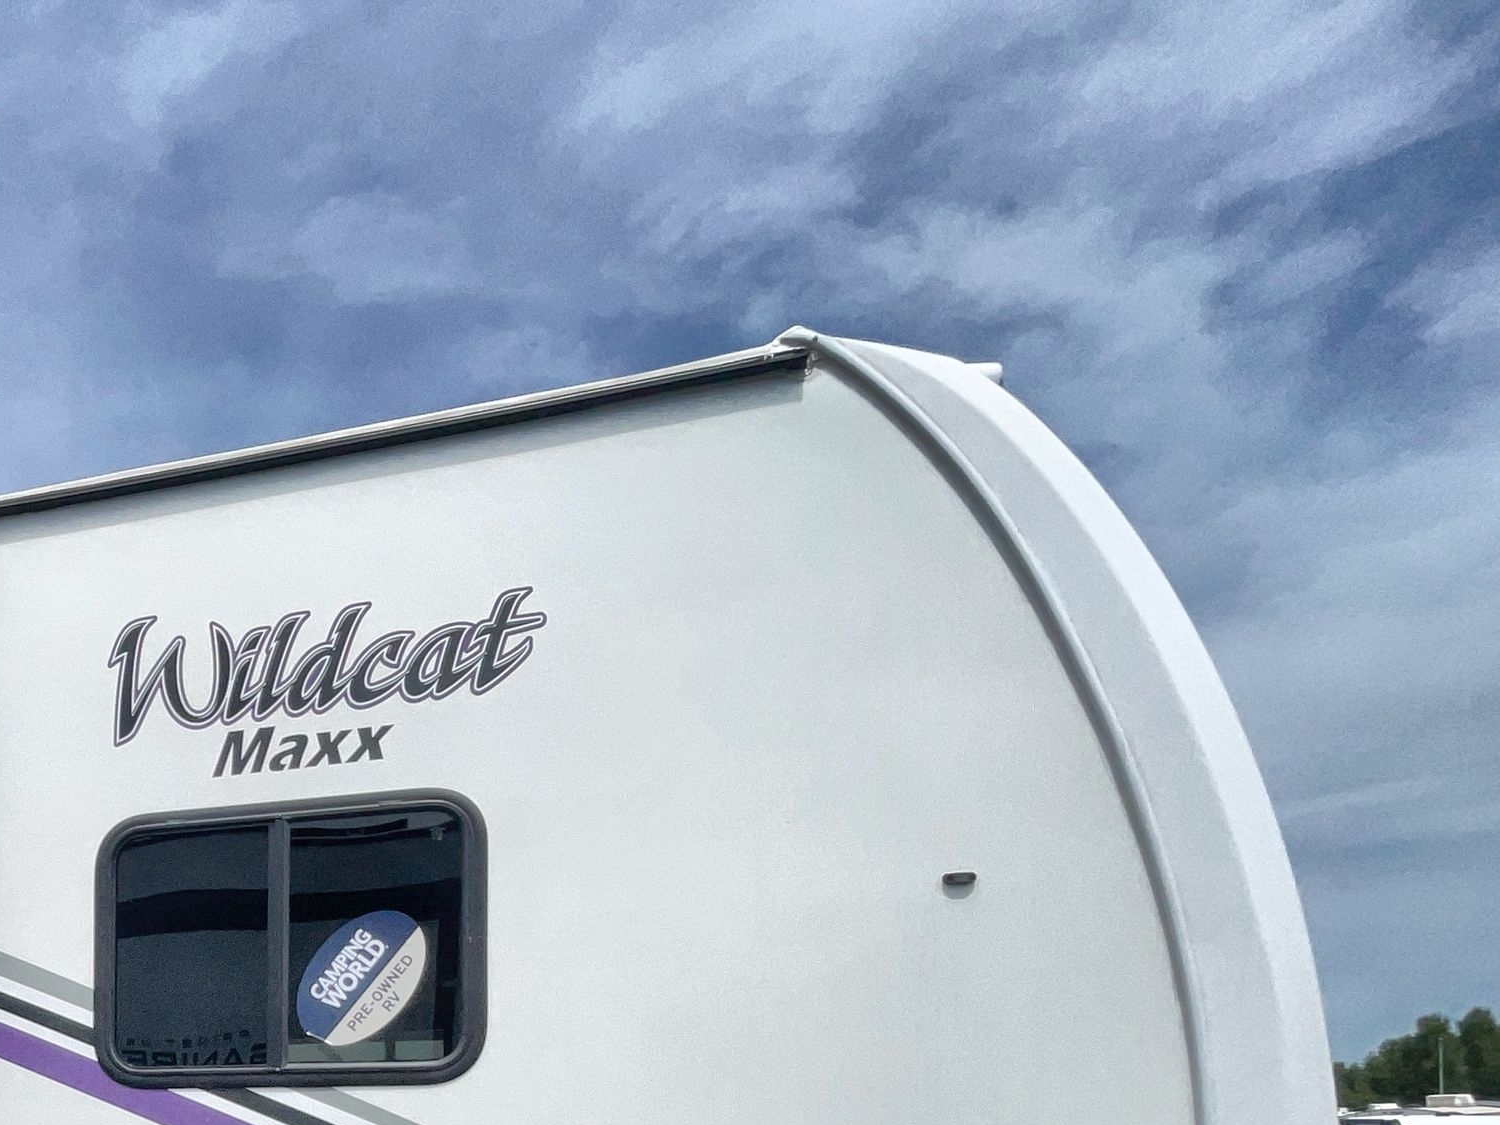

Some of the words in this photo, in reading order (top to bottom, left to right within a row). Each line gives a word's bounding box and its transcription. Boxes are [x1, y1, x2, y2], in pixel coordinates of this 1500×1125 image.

[107, 586, 547, 746] Wildcat
[211, 723, 395, 778] Maxx
[310, 928, 372, 1000] CAMPING
[321, 939, 386, 1008] WORLD
[346, 954, 413, 1032] PRE-OWNED
[381, 991, 401, 1012] RV
